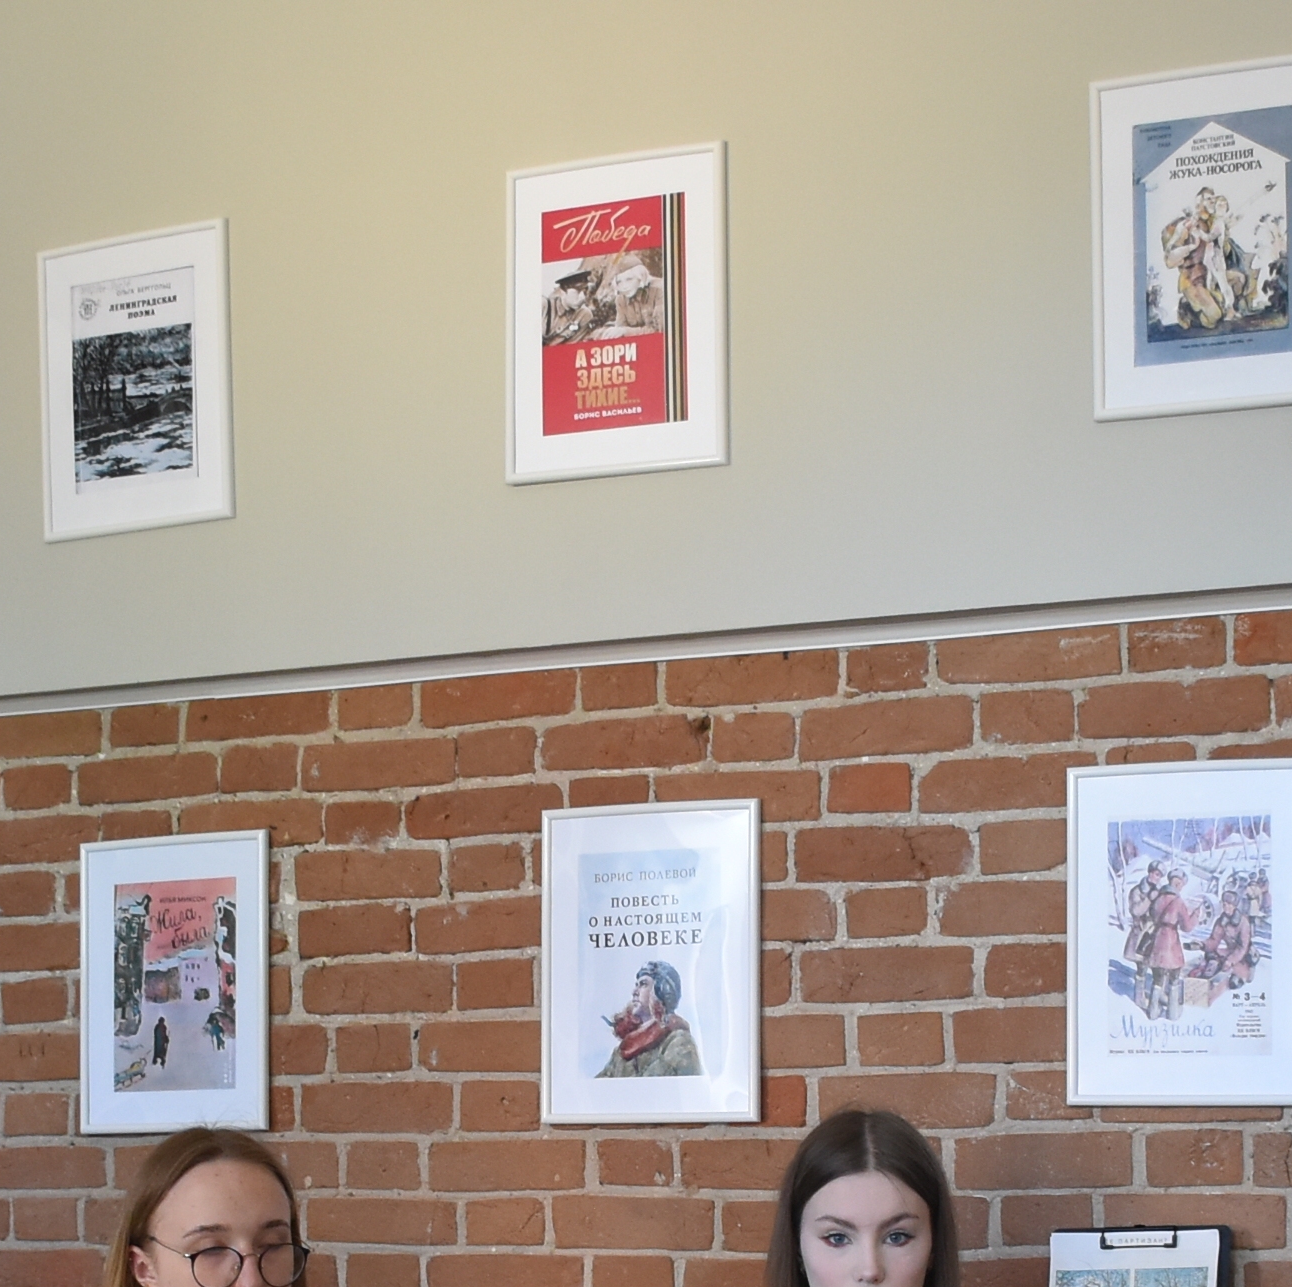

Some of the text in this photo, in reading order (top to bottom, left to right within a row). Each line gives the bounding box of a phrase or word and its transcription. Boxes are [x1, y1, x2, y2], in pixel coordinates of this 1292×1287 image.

[1191, 140, 1236, 152] ПАУСТОВСКИЙ
[1192, 134, 1235, 145] КОНСТАНТИН
[1175, 148, 1255, 168] ПОХОЖДЕНИЯ
[1169, 160, 1263, 180] ЖУКА-НОСОРОГА
[553, 206, 651, 265] Победа
[109, 295, 178, 312] ЛЕНИНГРАДСКАЯ
[127, 309, 156, 320] ПОЭМА
[575, 342, 637, 369] А ЗОРИ
[576, 364, 637, 390] ЗДЕСЬ
[574, 386, 641, 410] ТИХИЕ...
[573, 406, 643, 421] БОРИС ВАСИЛЬЕВ
[594, 867, 697, 884] БОРИС ПОЛЕВОЙ
[611, 894, 680, 909] ПОВЕСТЬ
[588, 911, 702, 928] О НАСТОЯЩЕМ
[170, 924, 211, 949] была
[588, 929, 703, 949] ЧЕЛОВЕКЕ
[1110, 1015, 1214, 1048] Мурзилка
